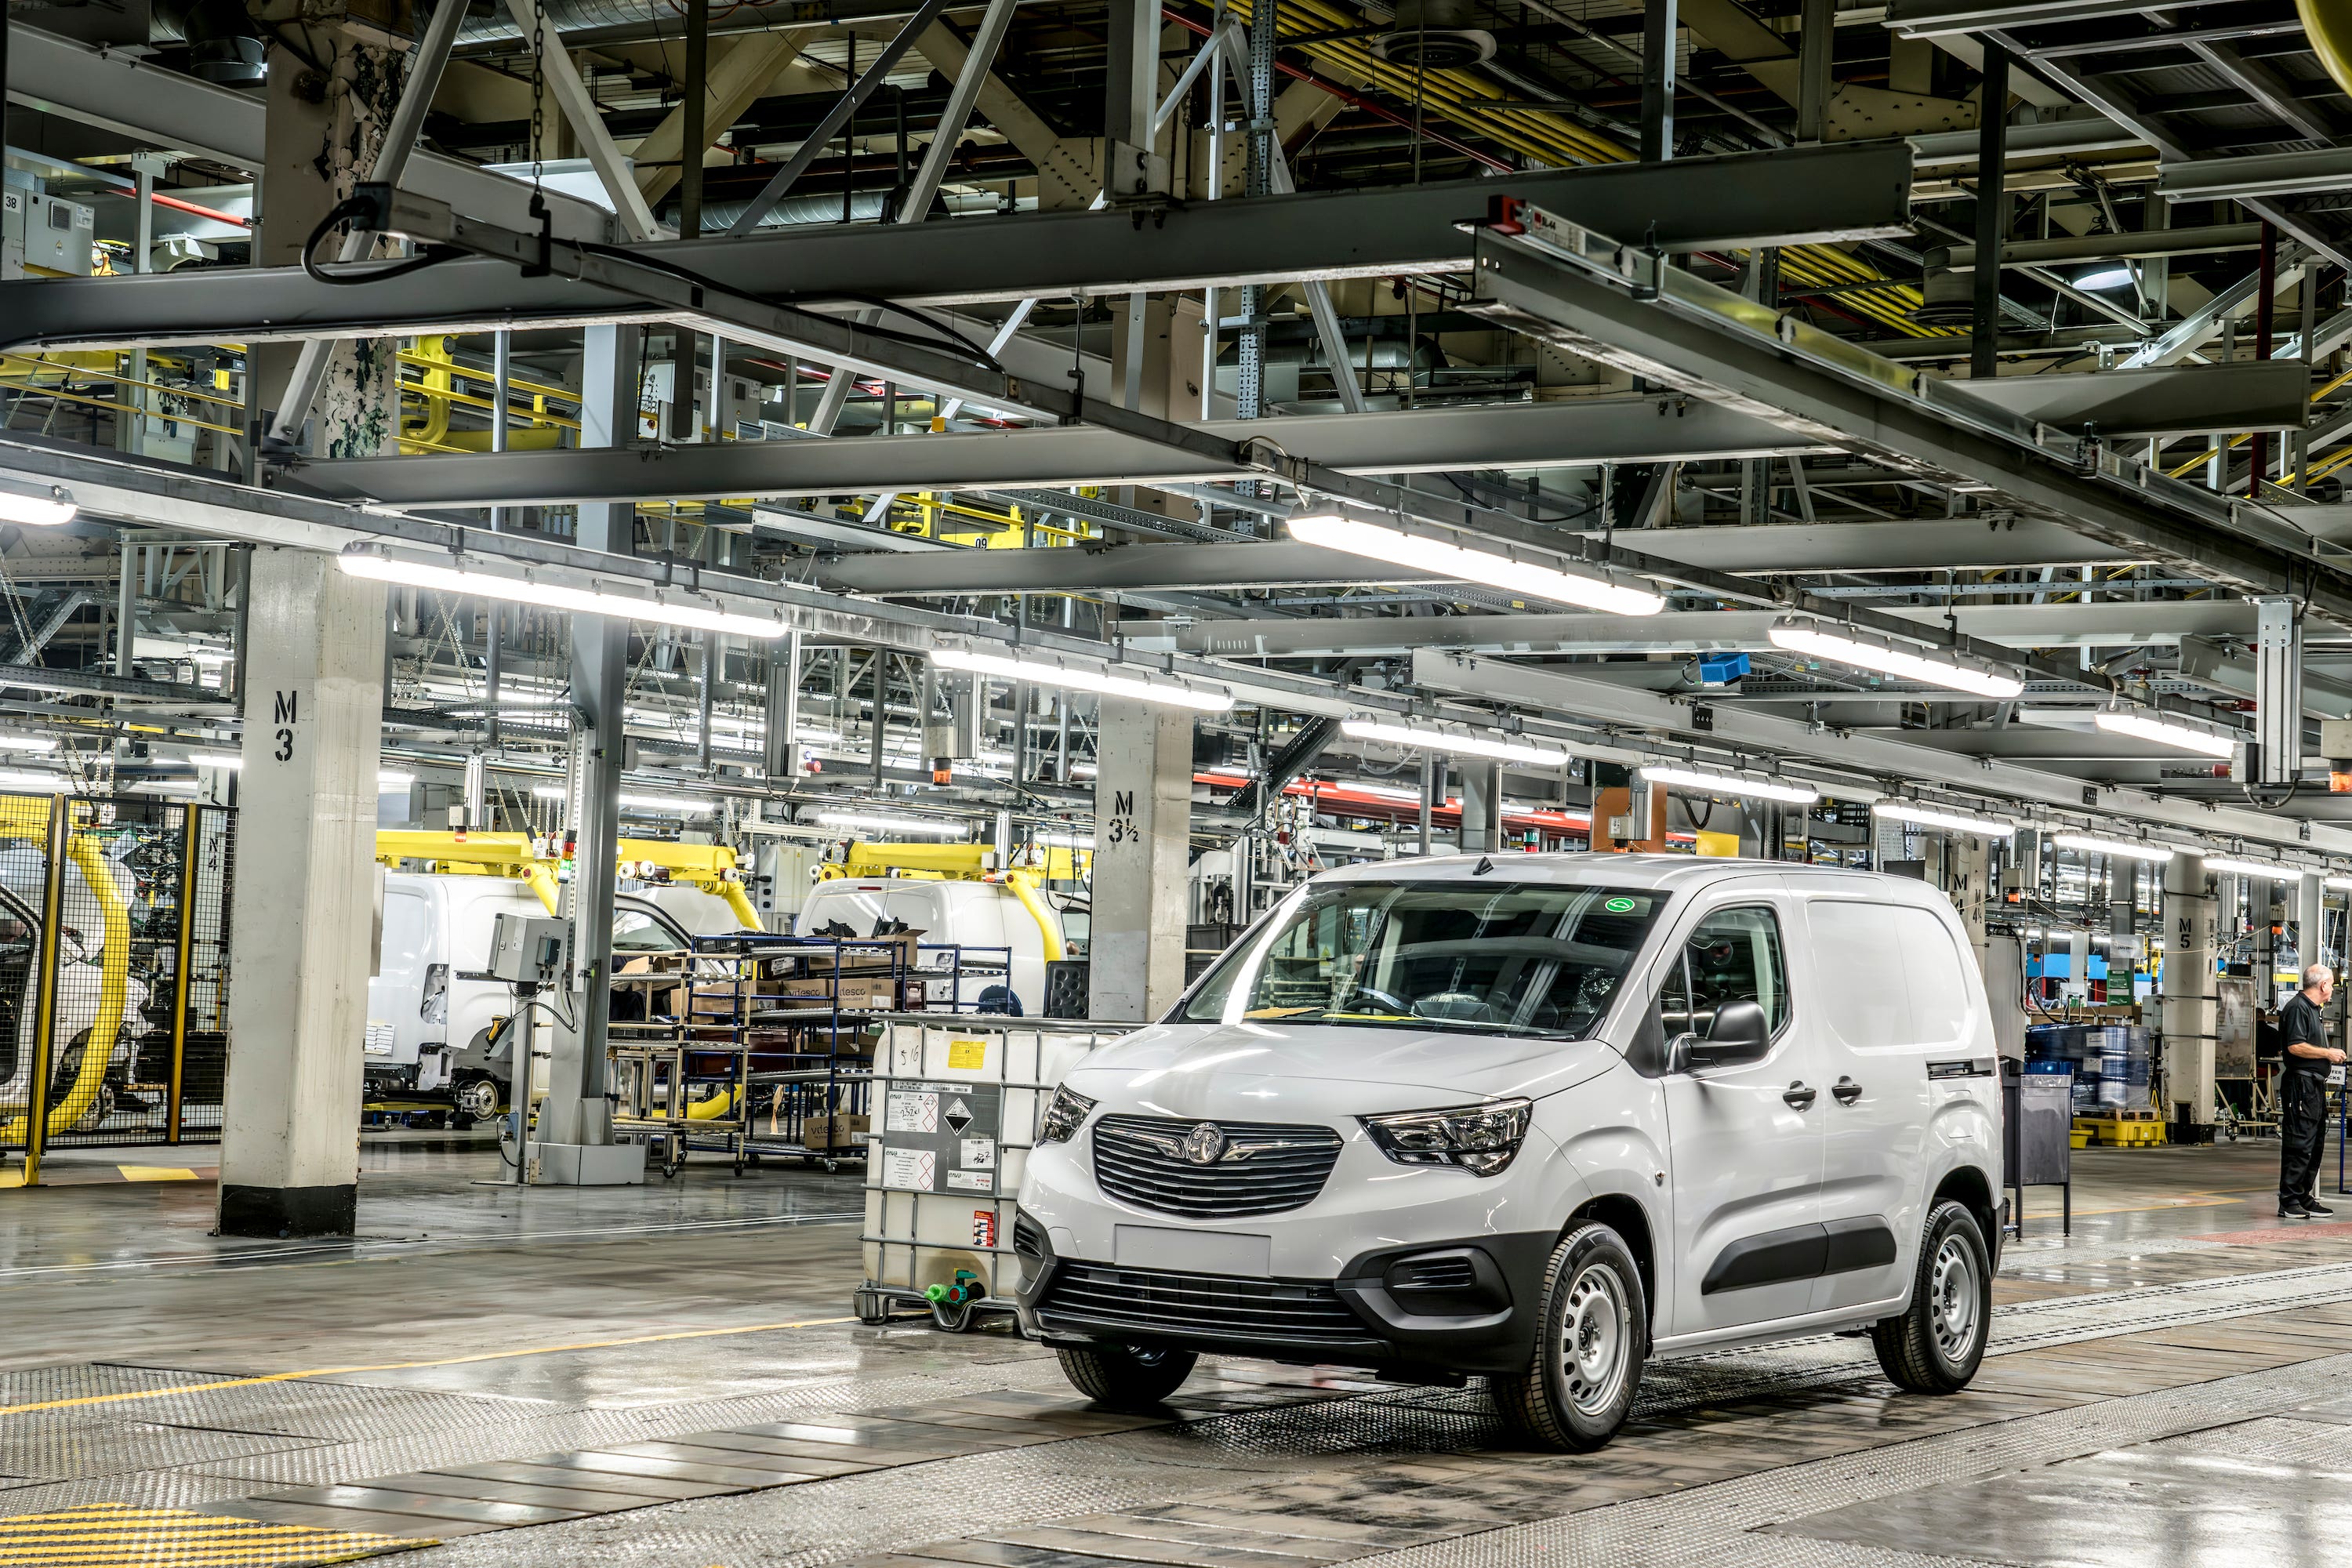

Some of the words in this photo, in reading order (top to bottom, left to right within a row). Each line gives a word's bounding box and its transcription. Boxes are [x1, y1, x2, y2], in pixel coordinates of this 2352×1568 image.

[5, 196, 16, 209] 38
[975, 538, 987, 549] 09
[274, 691, 297, 724] M
[274, 728, 293, 761] 3
[1116, 790, 1133, 815] M
[1954, 873, 1968, 891] M
[2179, 918, 2191, 933] M
[2180, 934, 2190, 949] 5
[811, 1124, 845, 1135] viteco
